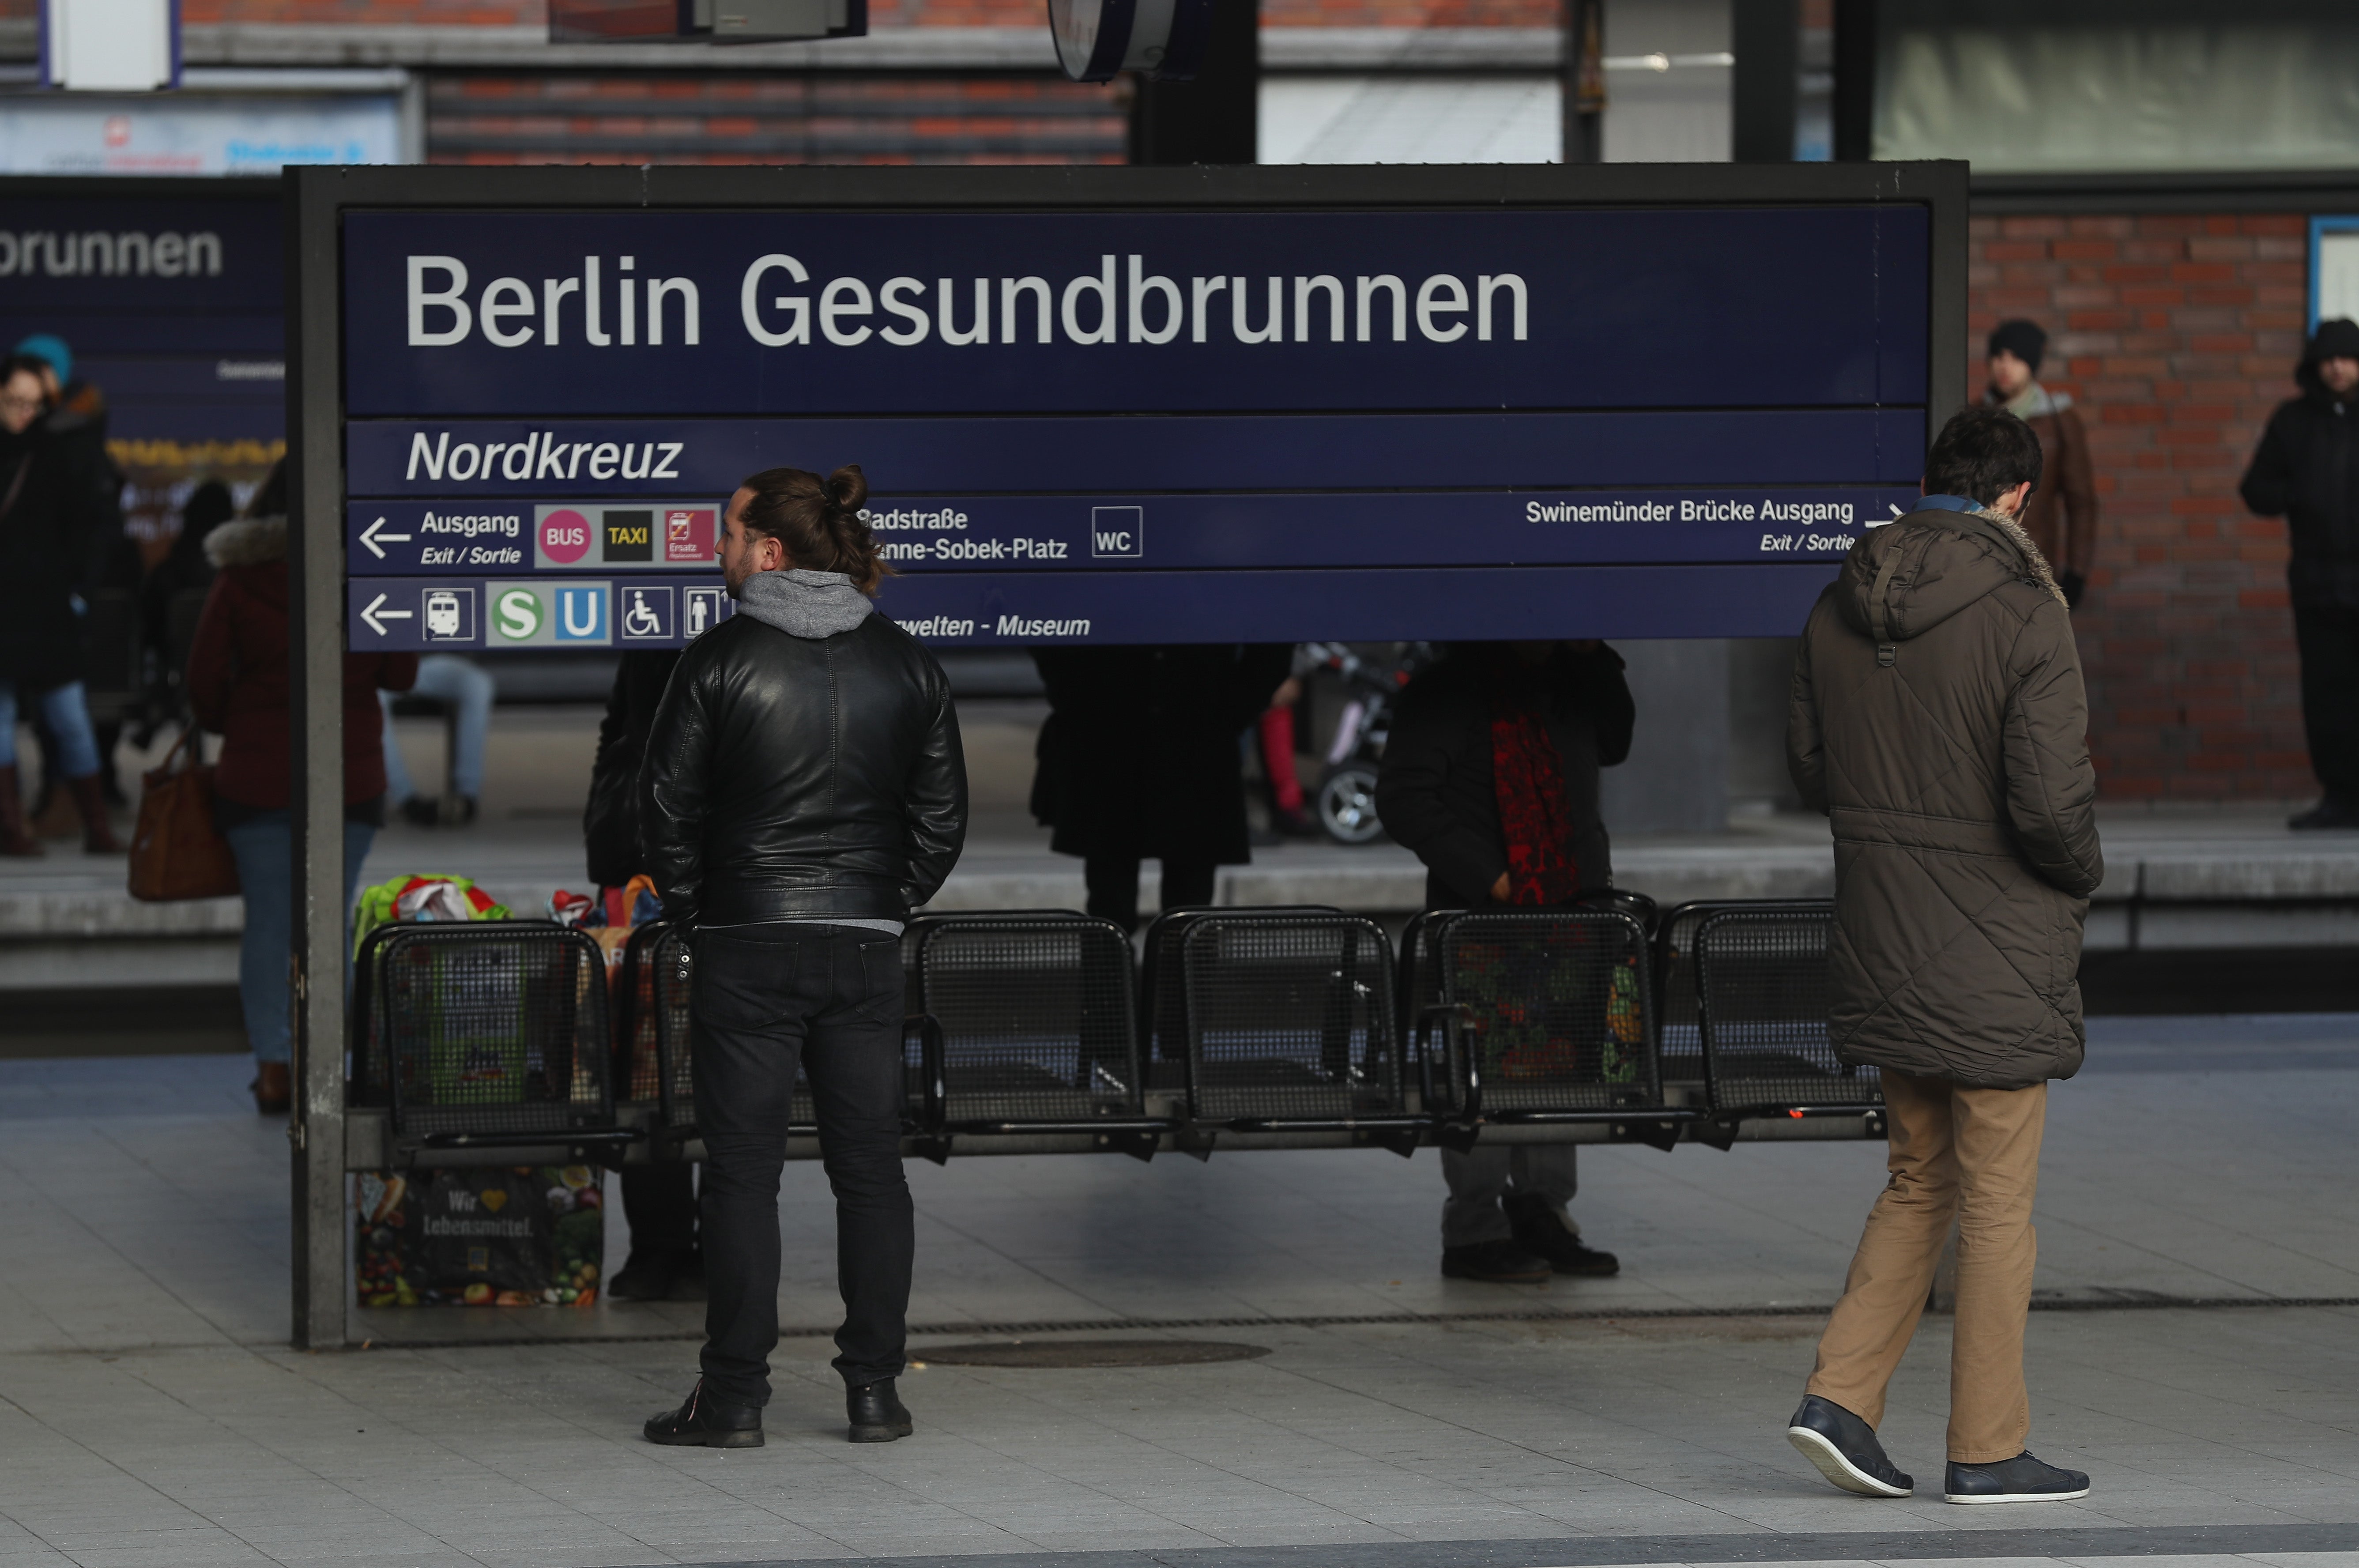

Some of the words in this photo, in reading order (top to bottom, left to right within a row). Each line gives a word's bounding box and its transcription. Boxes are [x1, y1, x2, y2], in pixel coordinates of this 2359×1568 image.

[407, 255, 700, 348] Berlin
[741, 253, 1528, 347] Gesundbrunnen
[406, 431, 684, 481] Nordkreuz
[867, 508, 968, 530] adstraße
[1526, 500, 1675, 523] Swinemünder
[1680, 499, 1756, 521] Brücke
[1759, 499, 1854, 525] Ausgang
[420, 511, 520, 538] Ausgang
[608, 527, 648, 545] TAXI
[546, 528, 585, 546] BUS
[669, 542, 697, 552] Ersatz
[1096, 531, 1132, 551] WC
[1760, 534, 1793, 551] Exit
[1794, 534, 1805, 551] /
[1806, 533, 1856, 551] Sortie
[420, 547, 456, 565] Exit
[456, 547, 468, 565] /
[469, 546, 522, 565] Sortie
[499, 590, 538, 639] S
[563, 591, 598, 637] U
[995, 614, 1091, 637] Museum
[448, 1189, 477, 1213] Wir
